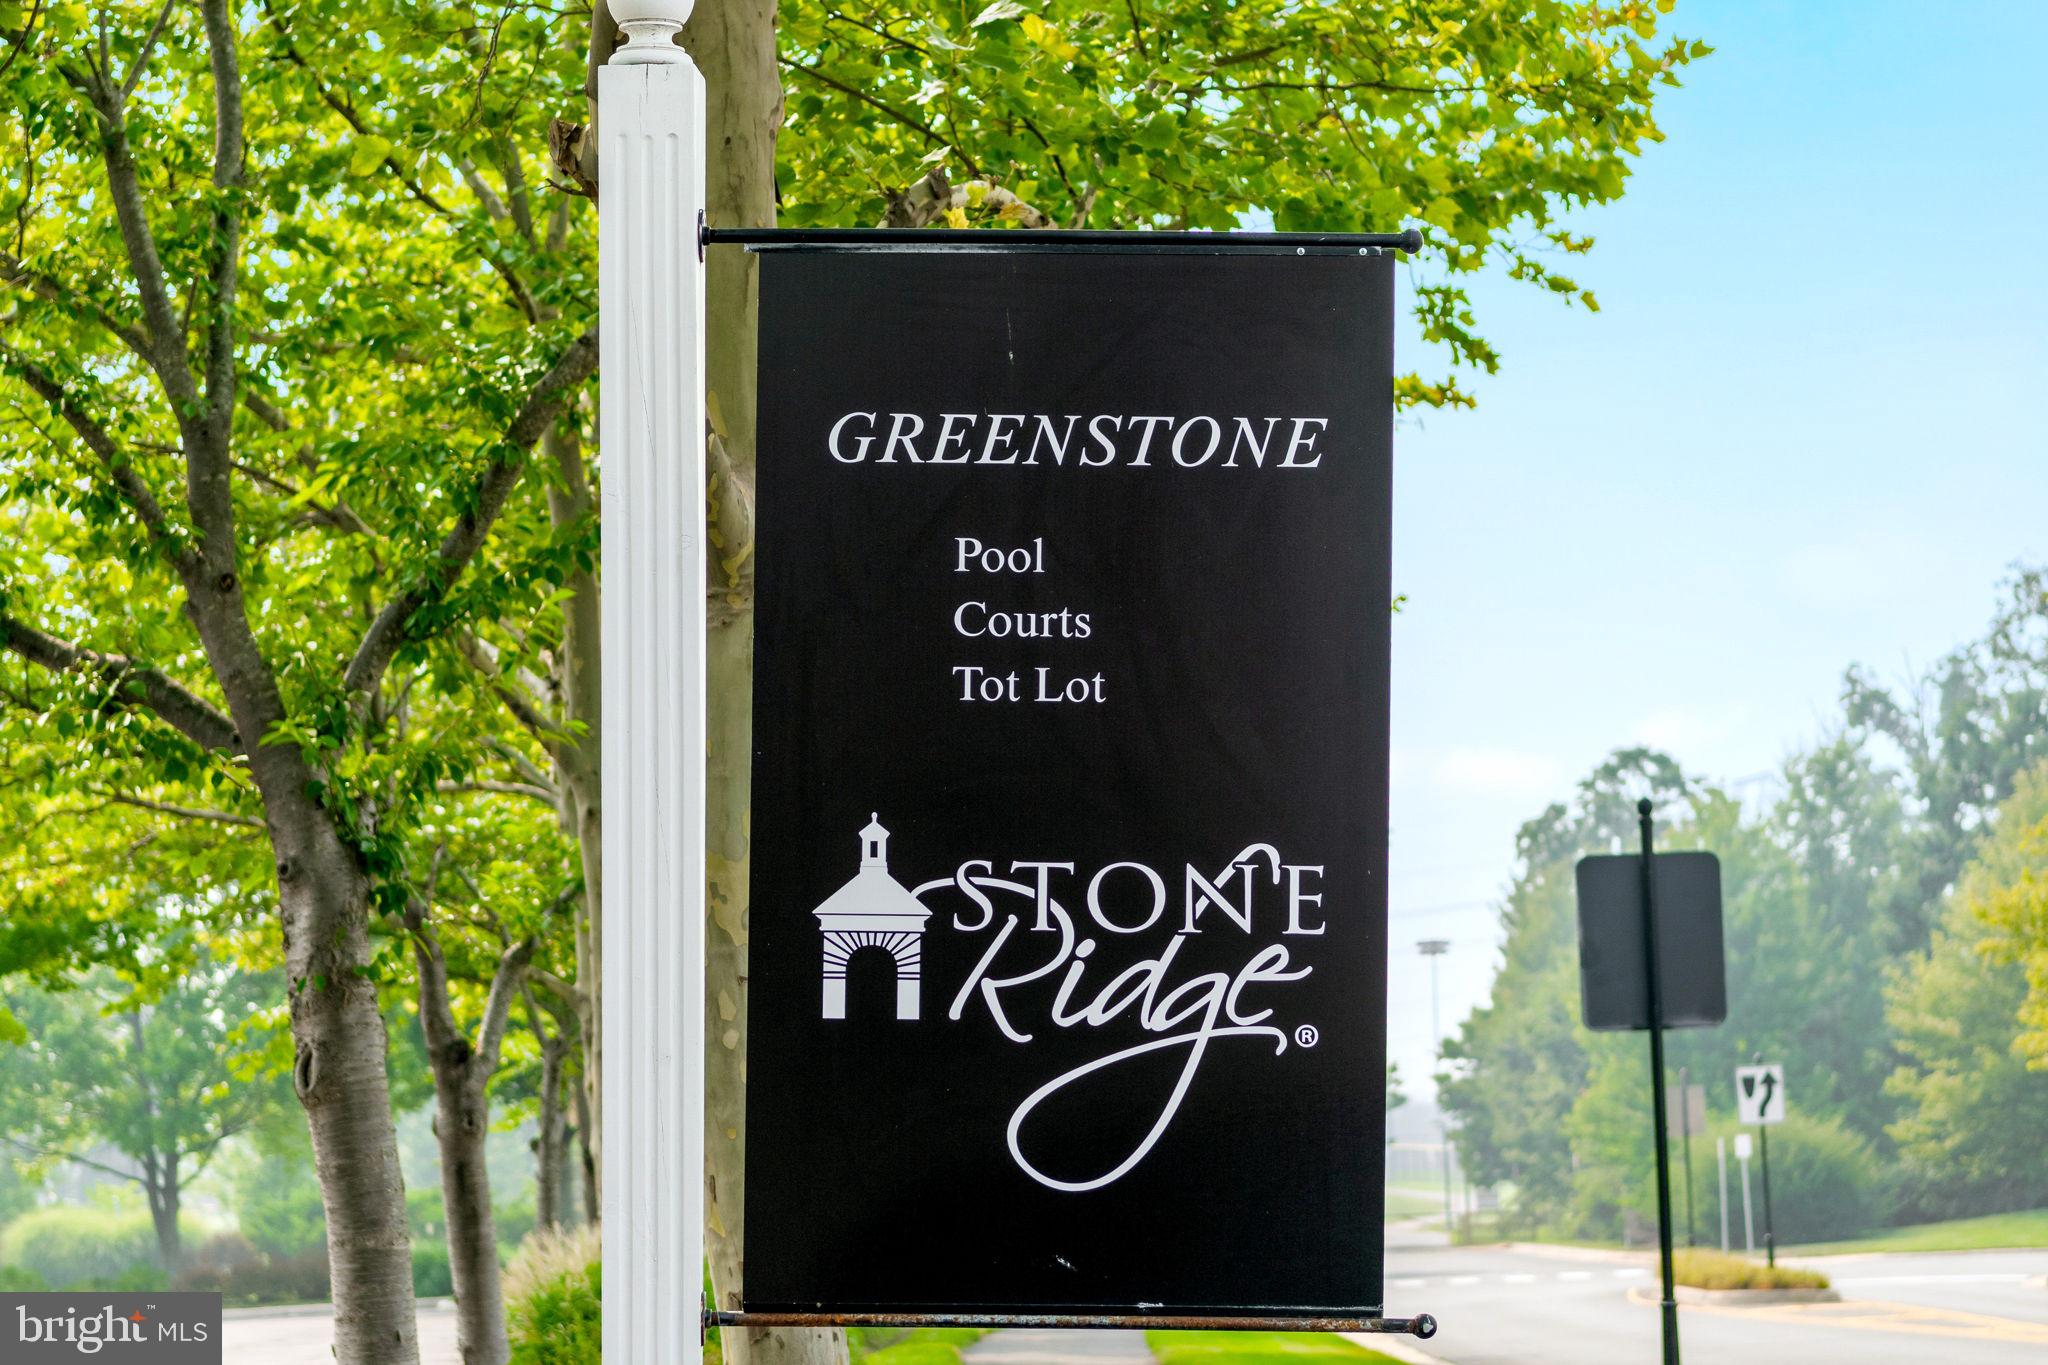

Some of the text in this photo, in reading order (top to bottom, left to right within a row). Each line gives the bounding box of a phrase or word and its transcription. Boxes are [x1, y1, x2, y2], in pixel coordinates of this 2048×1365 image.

[828, 411, 1329, 469] GREENSTONE
[954, 537, 1046, 574] Pool
[953, 601, 1092, 639] Courts
[952, 666, 1107, 703] Tot Lot
[952, 859, 1327, 936] STONE
[948, 912, 1314, 1193] Ridge
